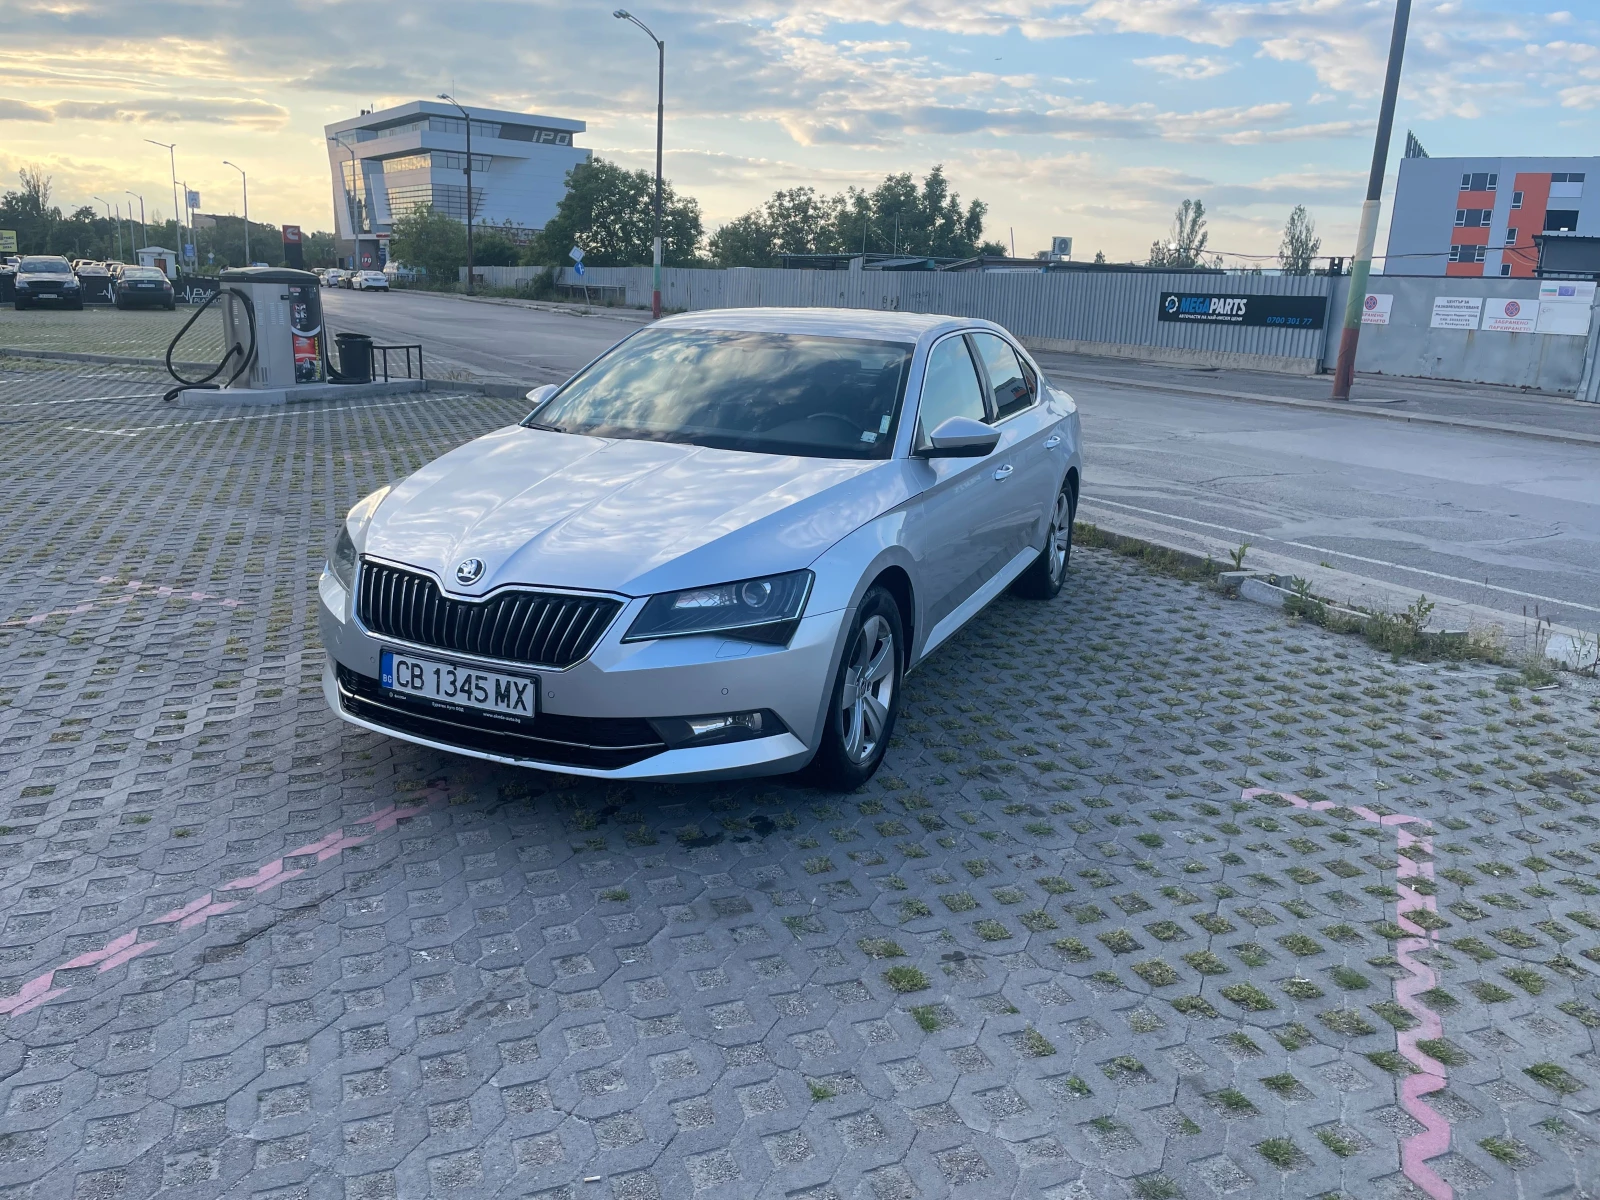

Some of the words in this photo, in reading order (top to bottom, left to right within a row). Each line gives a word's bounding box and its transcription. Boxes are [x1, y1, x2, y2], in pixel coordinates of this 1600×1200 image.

[531, 129, 571, 146] IPO
[1180, 297, 1247, 315] MEGAPARTS
[1266, 316, 1285, 324] 0700
[1286, 317, 1300, 325] 301
[382, 673, 393, 684] BG
[396, 660, 425, 691] CB
[433, 667, 489, 704] 1345
[494, 678, 529, 712] MX
